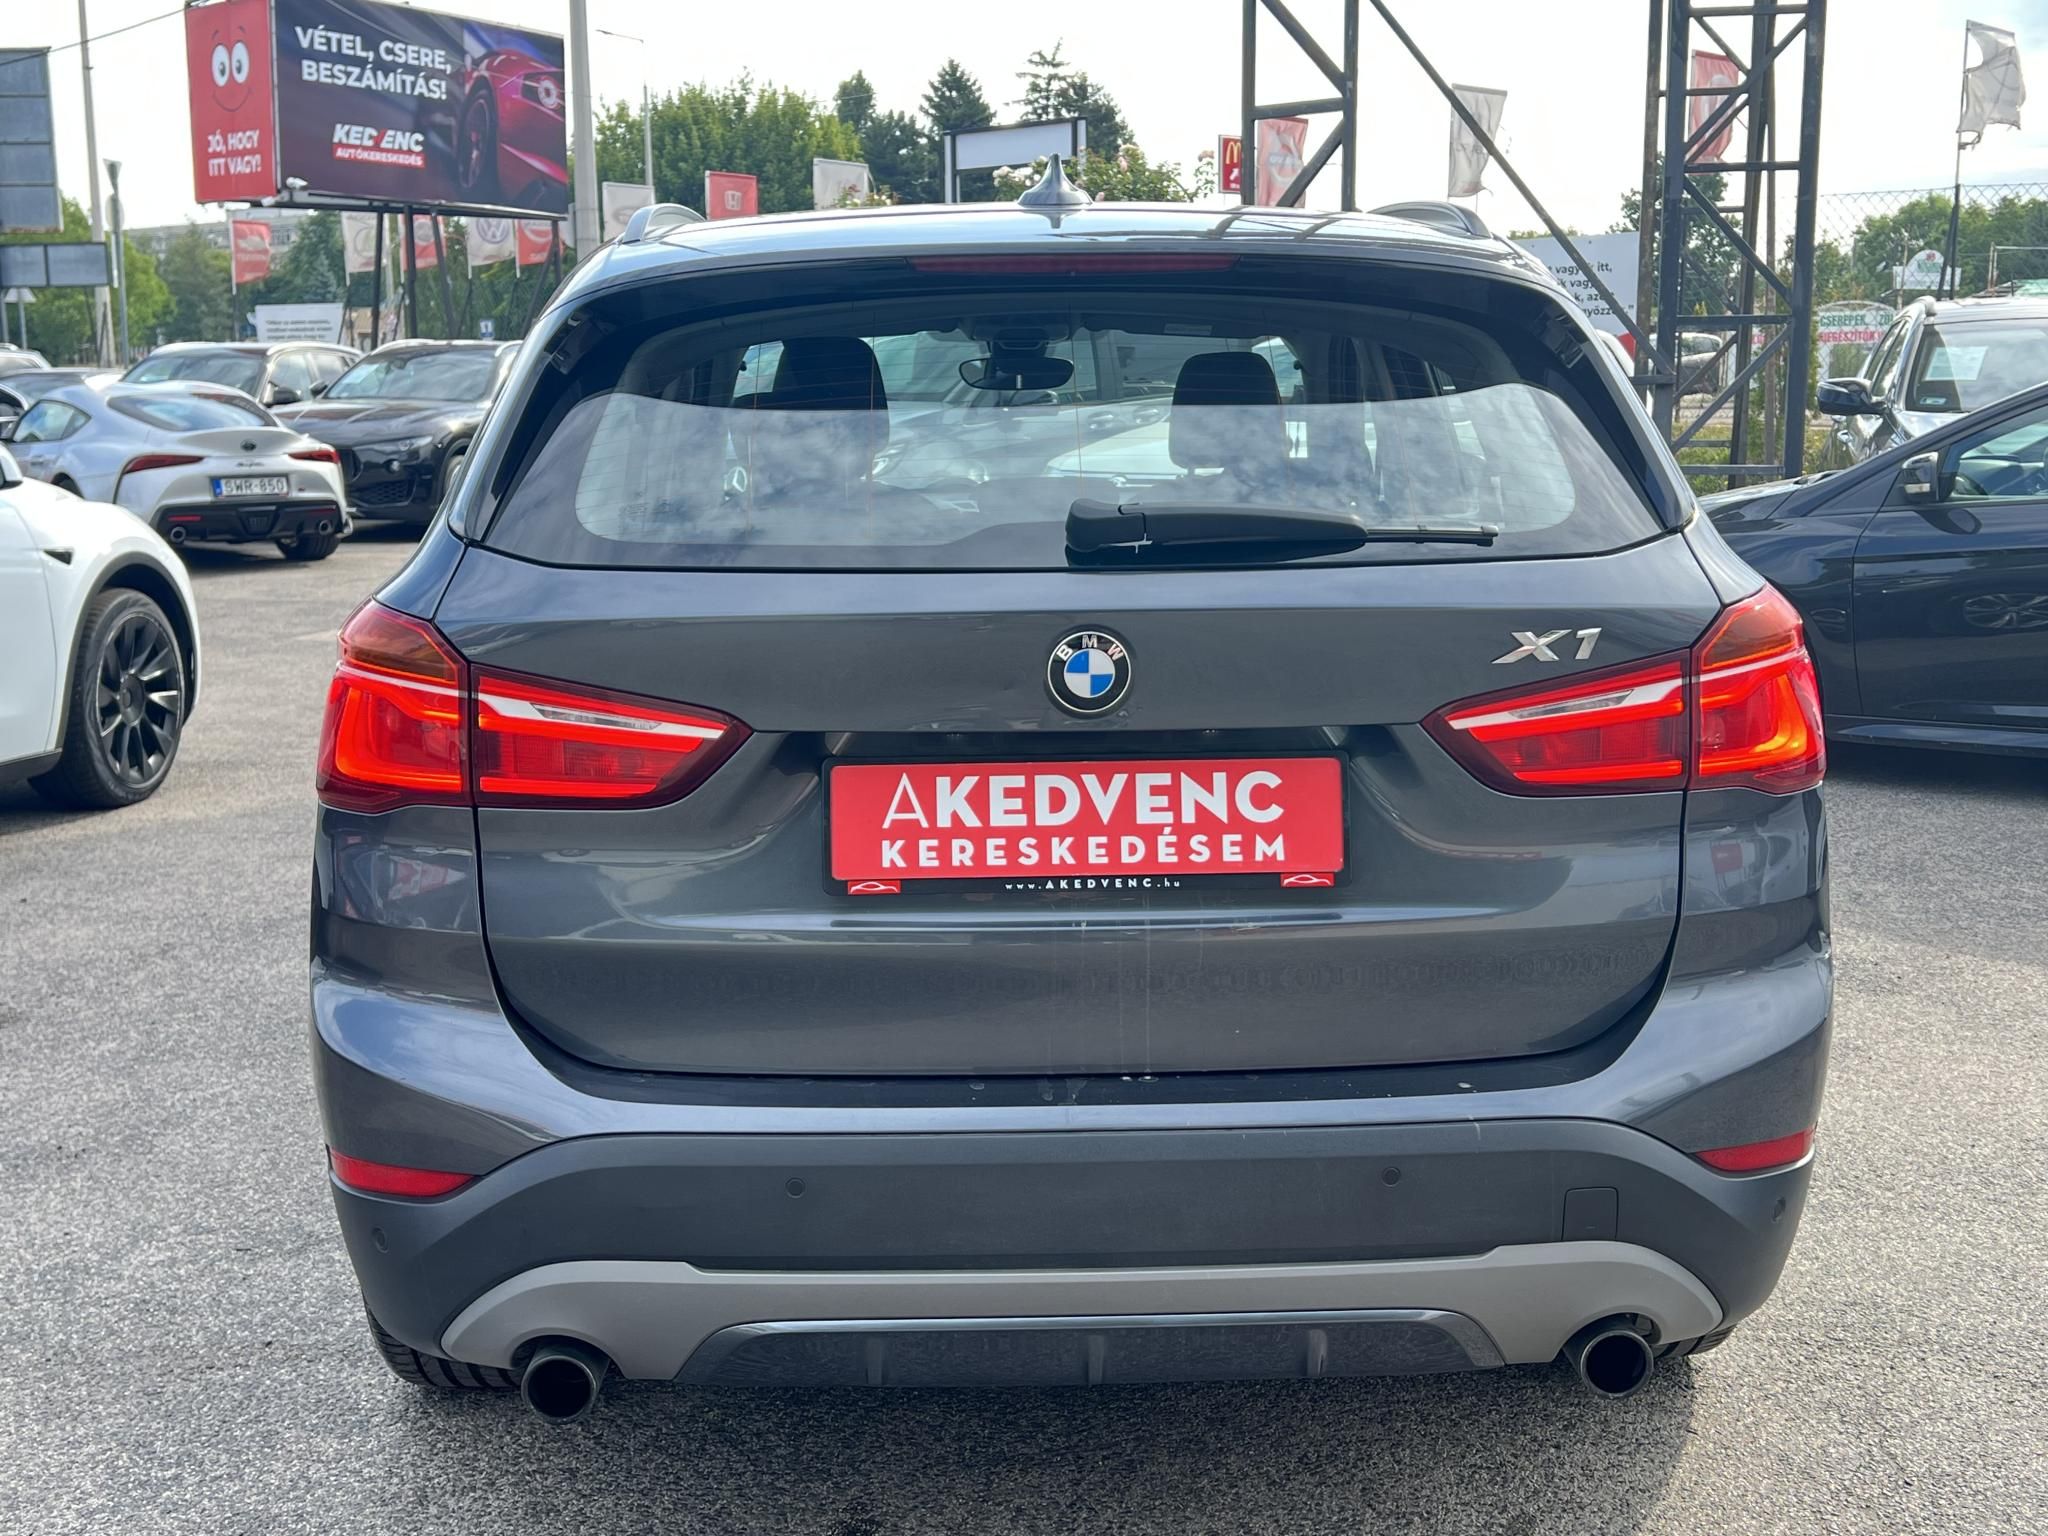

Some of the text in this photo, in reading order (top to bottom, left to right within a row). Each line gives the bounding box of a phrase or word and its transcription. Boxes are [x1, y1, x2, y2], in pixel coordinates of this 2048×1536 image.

[295, 25, 452, 75] VÉTEL, CSERE,
[301, 59, 447, 100] BESZÁMÍTÁS!
[208, 154, 261, 177] ITT VAGY!
[1056, 634, 1124, 661] BMW
[1491, 627, 1602, 664] X1
[882, 770, 1285, 830] AKEDVENC
[881, 828, 1286, 868] KERESKEDÉSEM
[1005, 877, 1180, 890] www.AKEDVENC.hu
